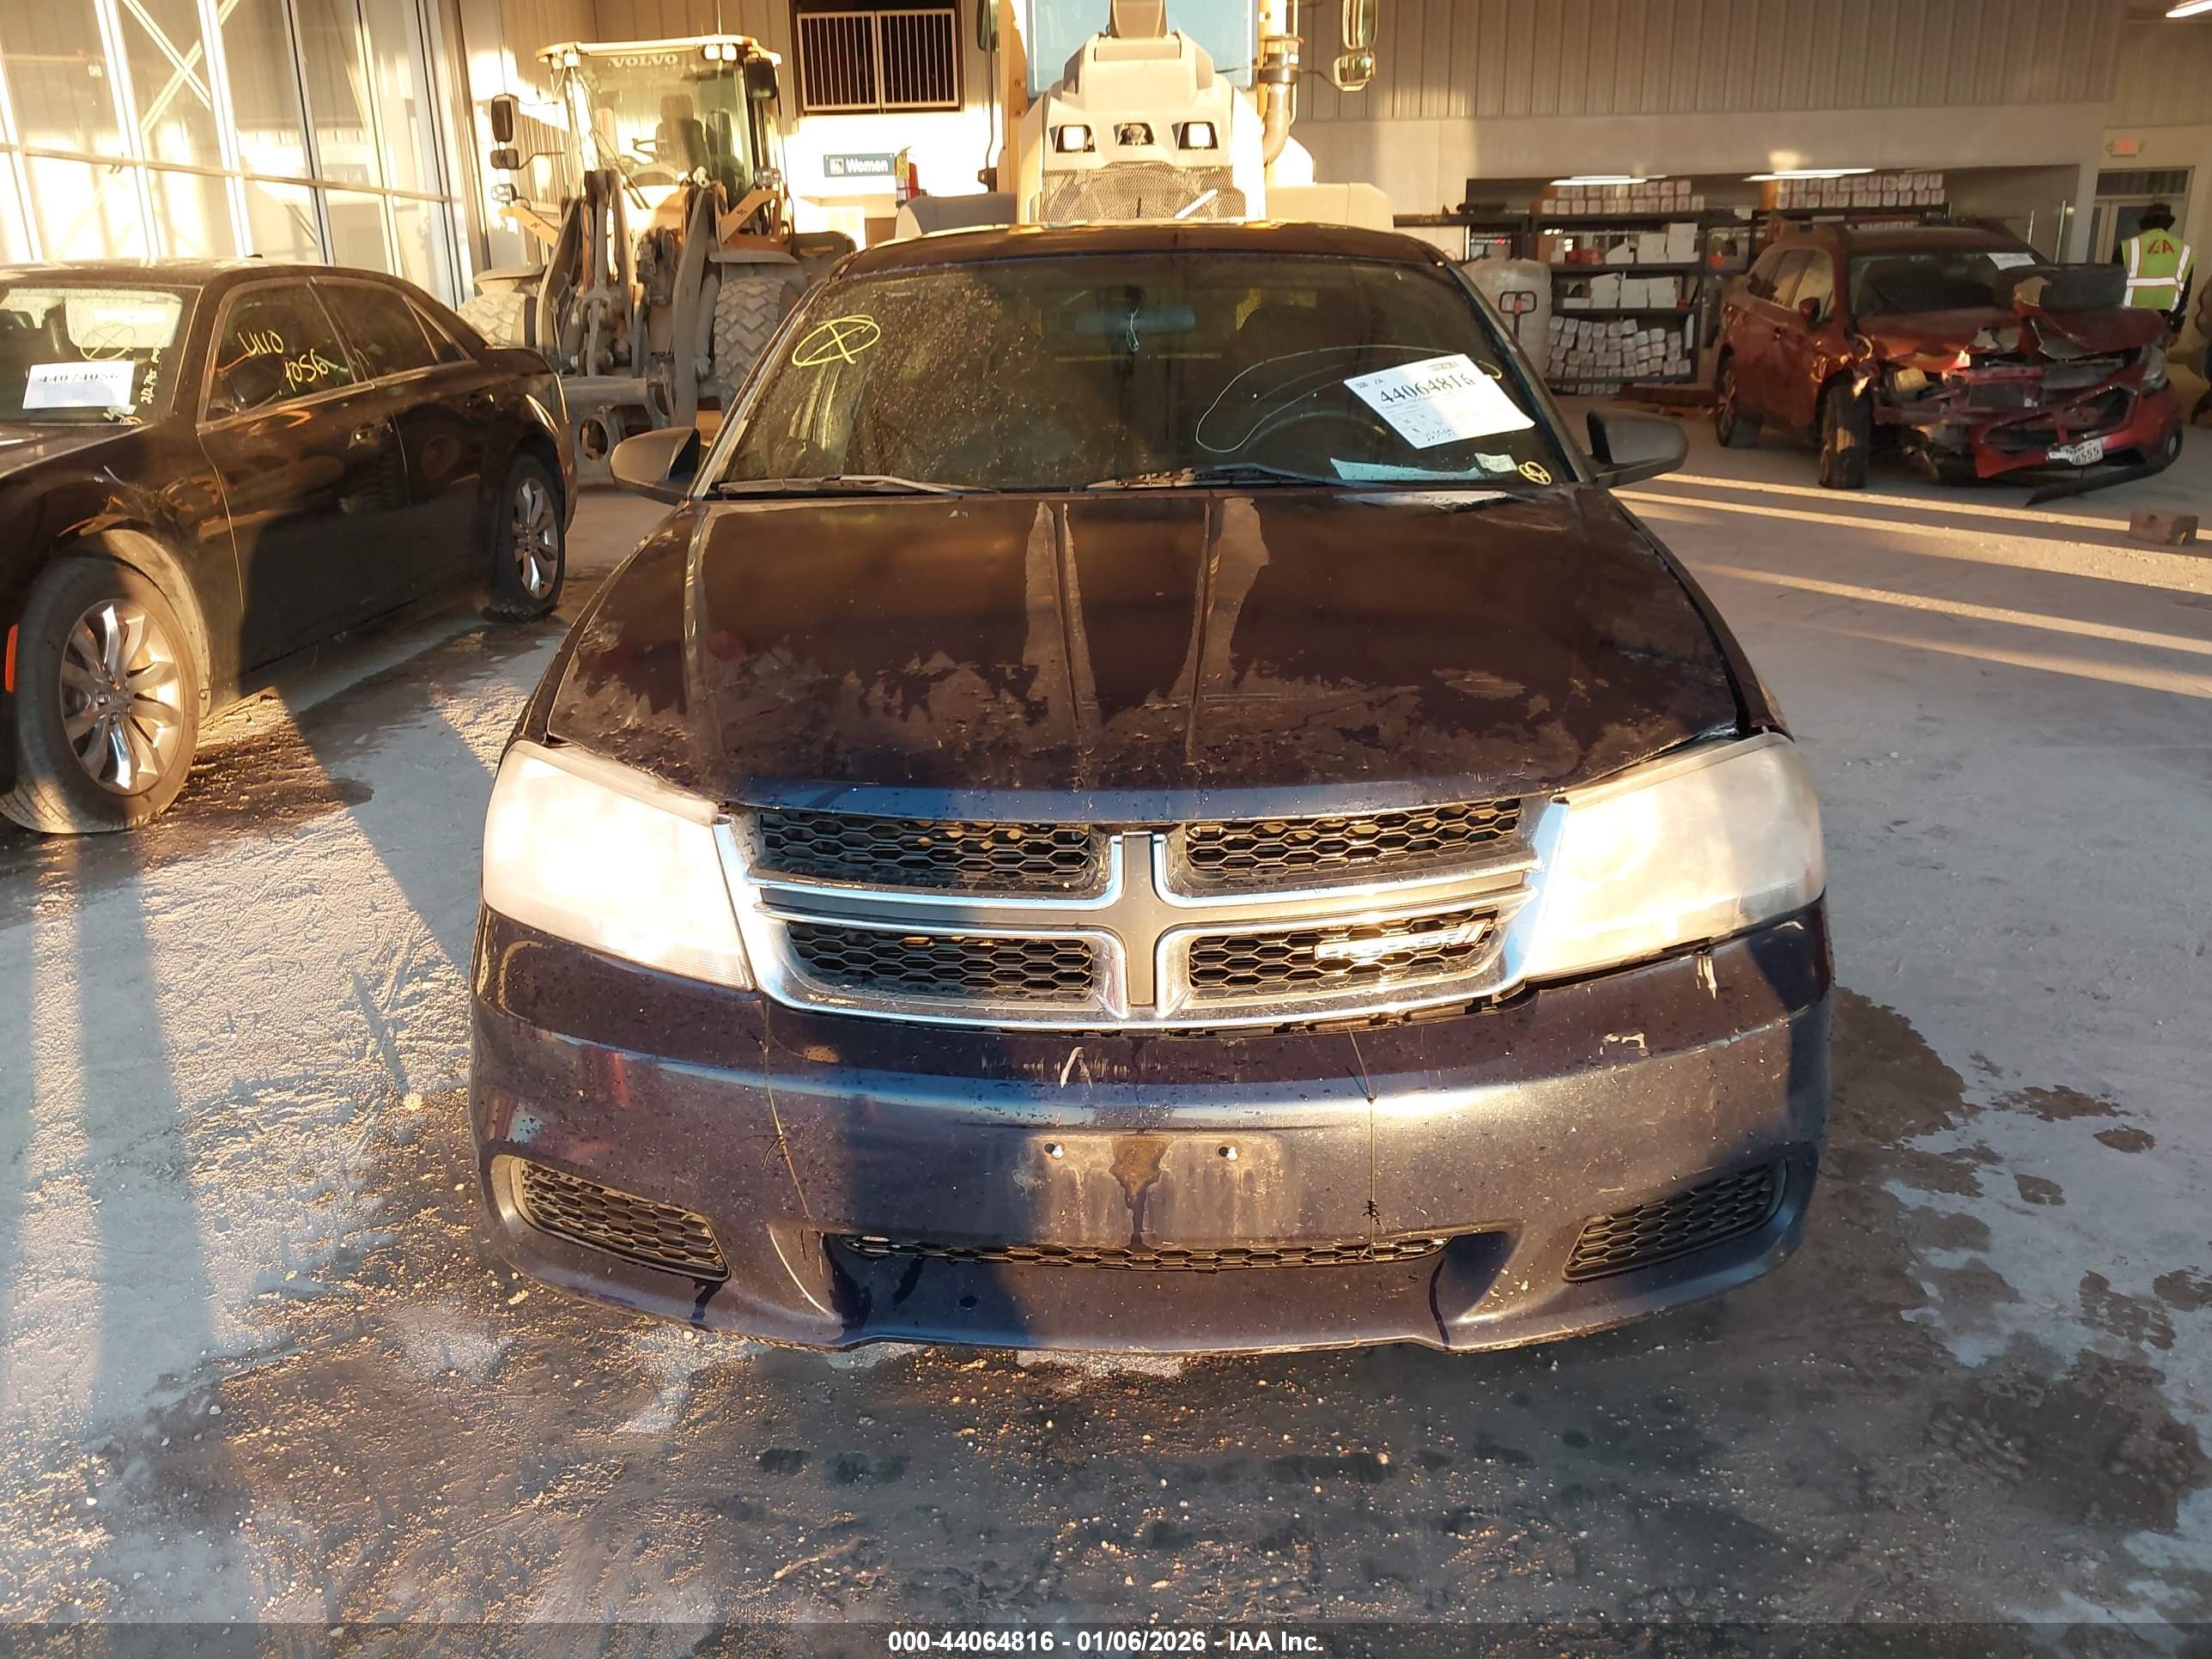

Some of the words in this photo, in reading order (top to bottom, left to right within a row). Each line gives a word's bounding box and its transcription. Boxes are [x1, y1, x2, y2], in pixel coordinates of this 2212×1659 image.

[610, 54, 678, 68] VOLVO
[846, 158, 889, 173] Women
[1381, 373, 1476, 404] 44064816
